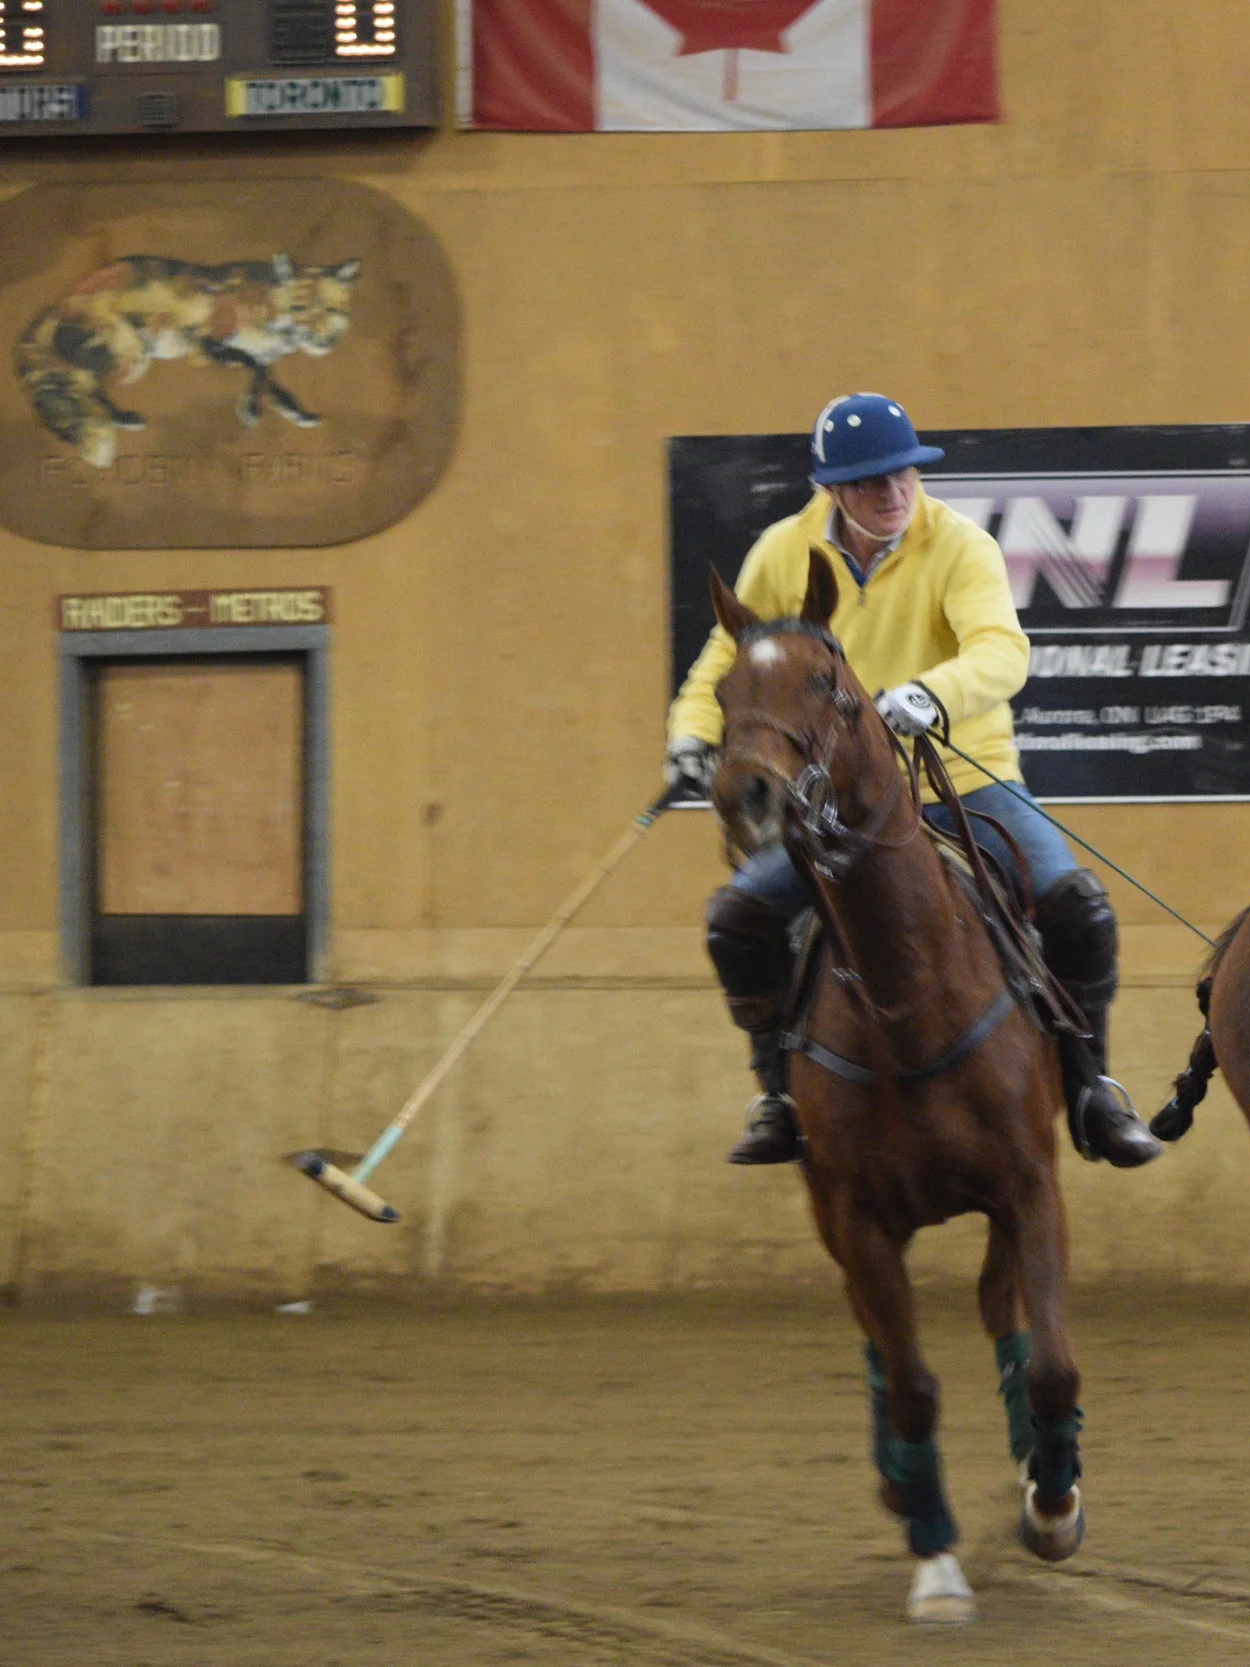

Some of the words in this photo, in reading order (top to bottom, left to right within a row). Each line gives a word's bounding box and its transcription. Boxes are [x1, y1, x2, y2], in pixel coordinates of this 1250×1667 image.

[95, 23, 221, 62] PERIOD
[244, 77, 380, 112] TORONTO
[61, 594, 184, 629] RAIDERS
[209, 589, 324, 624] METROS
